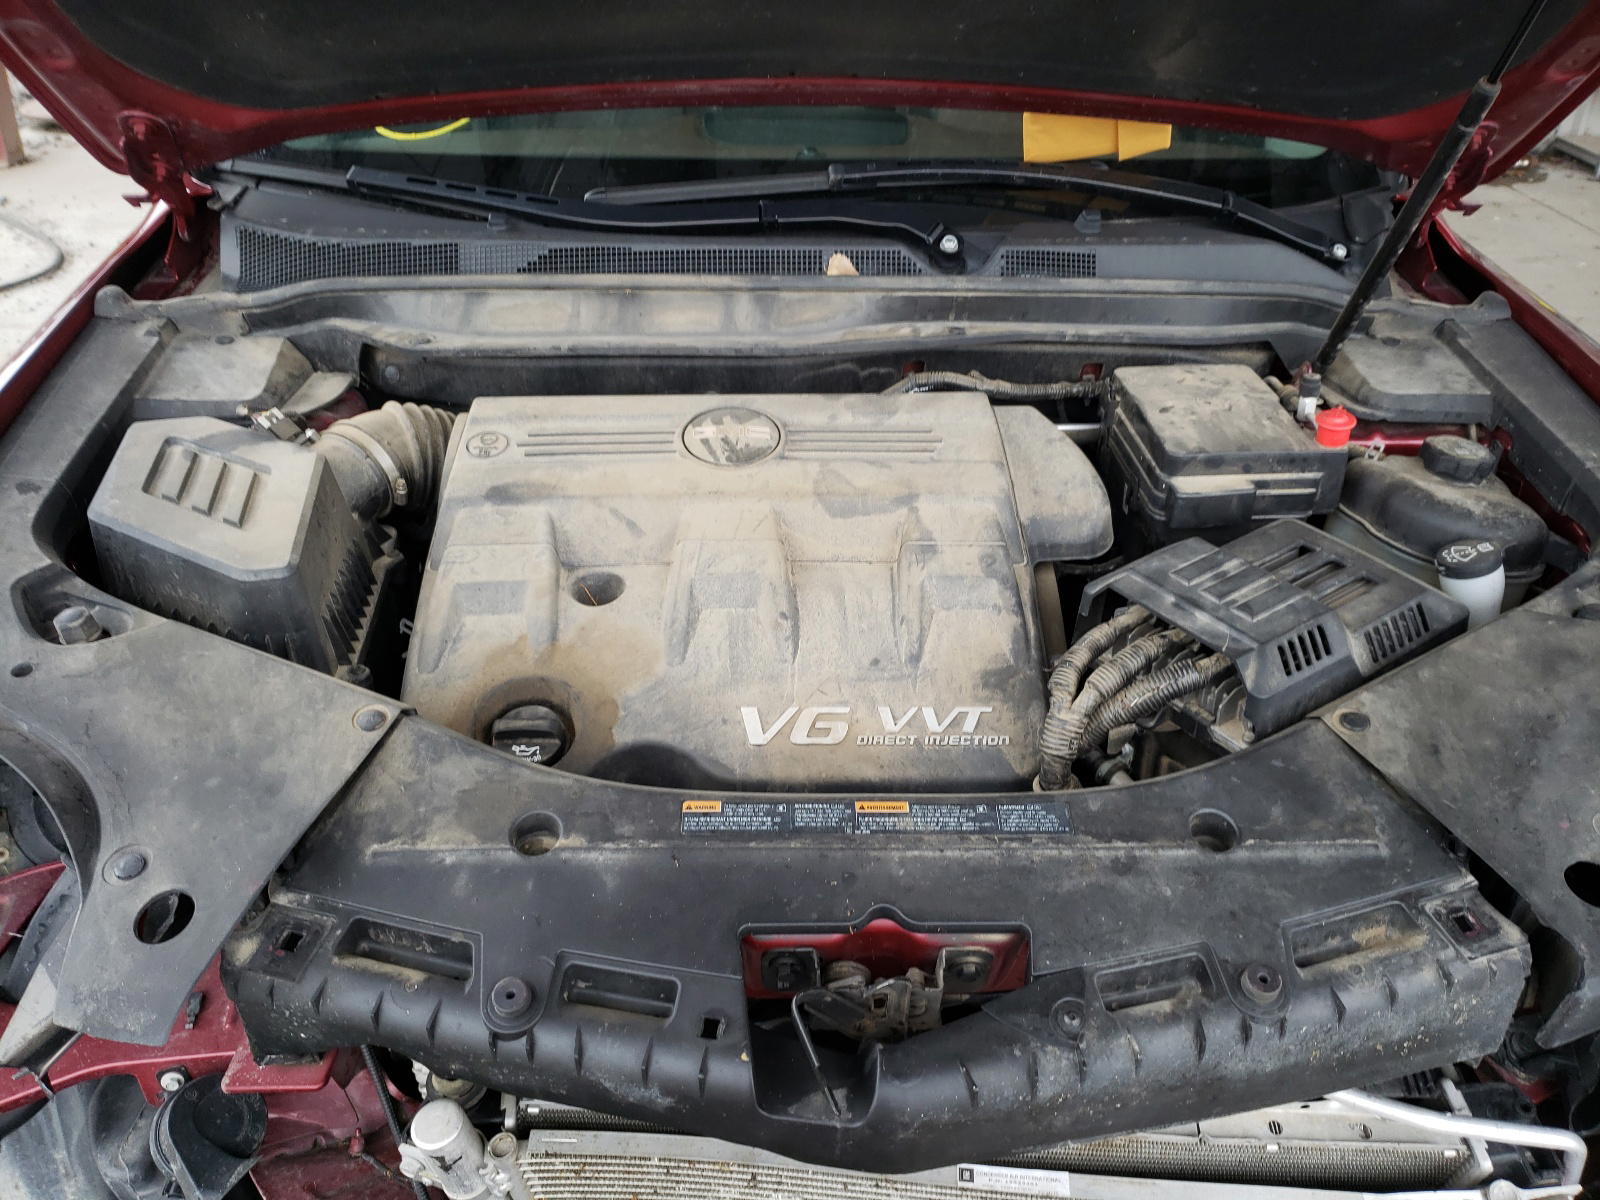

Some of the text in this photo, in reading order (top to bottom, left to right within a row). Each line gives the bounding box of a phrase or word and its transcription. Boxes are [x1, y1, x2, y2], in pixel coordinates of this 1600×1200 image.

[740, 705, 851, 746] V6
[877, 705, 993, 734] VVT
[855, 735, 1010, 747] DIRECT INJECTION
